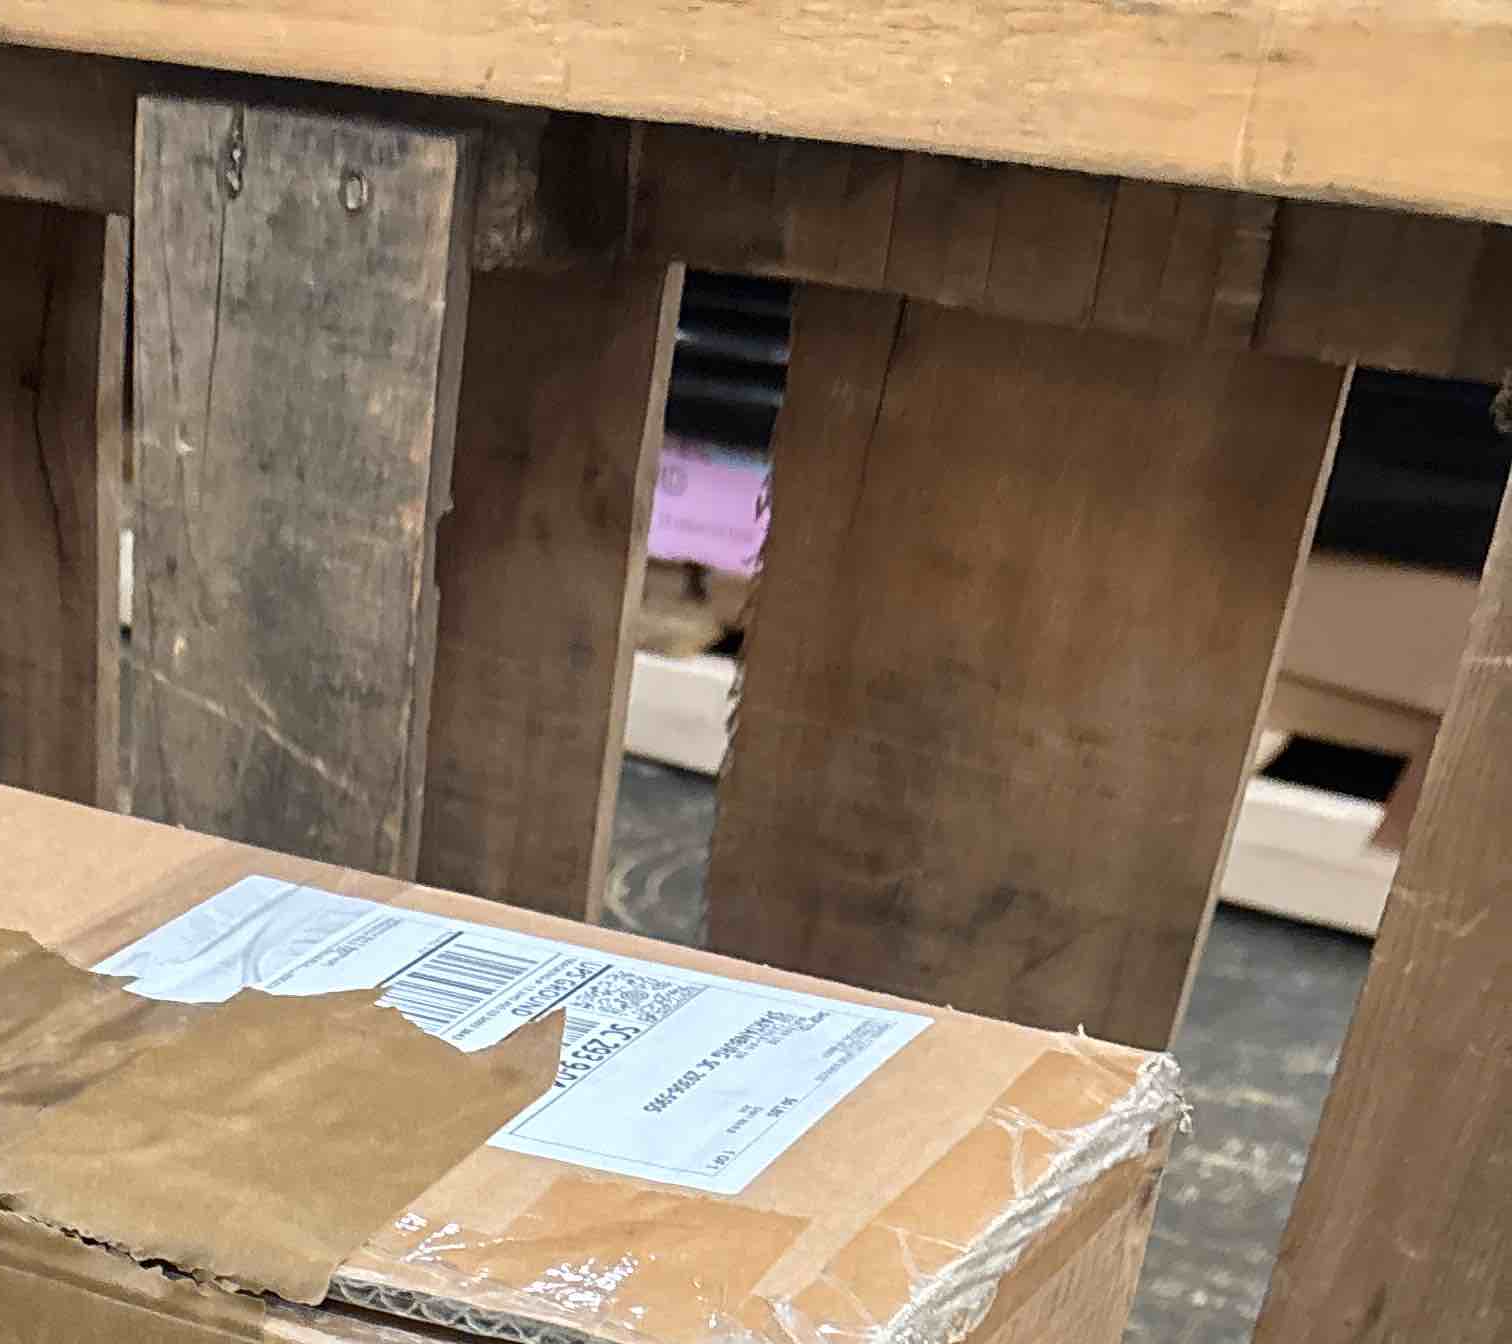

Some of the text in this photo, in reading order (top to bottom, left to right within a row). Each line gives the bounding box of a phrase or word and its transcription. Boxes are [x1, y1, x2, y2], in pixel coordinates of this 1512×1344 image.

[511, 979, 576, 1016] GROUND
[598, 1023, 641, 1041] SC
[572, 1037, 620, 1062] 293
